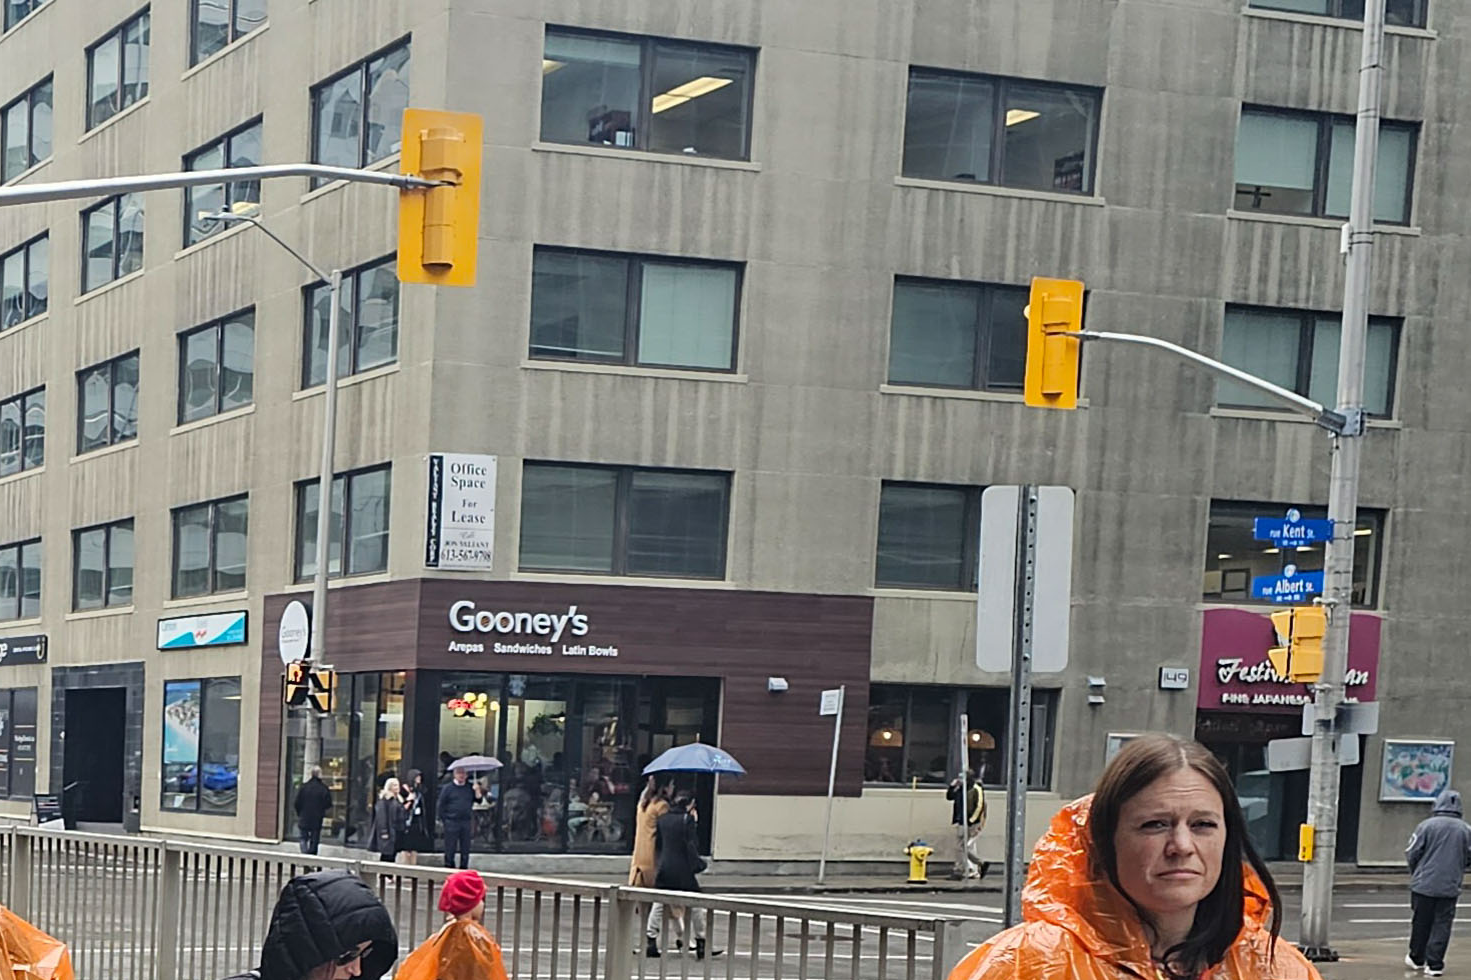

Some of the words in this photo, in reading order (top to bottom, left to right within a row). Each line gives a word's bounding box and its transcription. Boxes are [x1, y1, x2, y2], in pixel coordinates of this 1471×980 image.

[450, 462, 487, 476] Office
[450, 476, 486, 491] Space
[461, 499, 478, 509] For
[451, 510, 486, 524] Lease
[1282, 524, 1305, 538] Kent
[1274, 579, 1304, 594] Albert
[449, 600, 589, 643] Gooney's
[448, 641, 484, 654] Arepas
[494, 642, 552, 655] Sandwiches
[562, 645, 586, 656] Latin
[588, 645, 618, 657] Bowls
[1164, 673, 1187, 681] 149
[1217, 658, 1294, 684] Festiv
